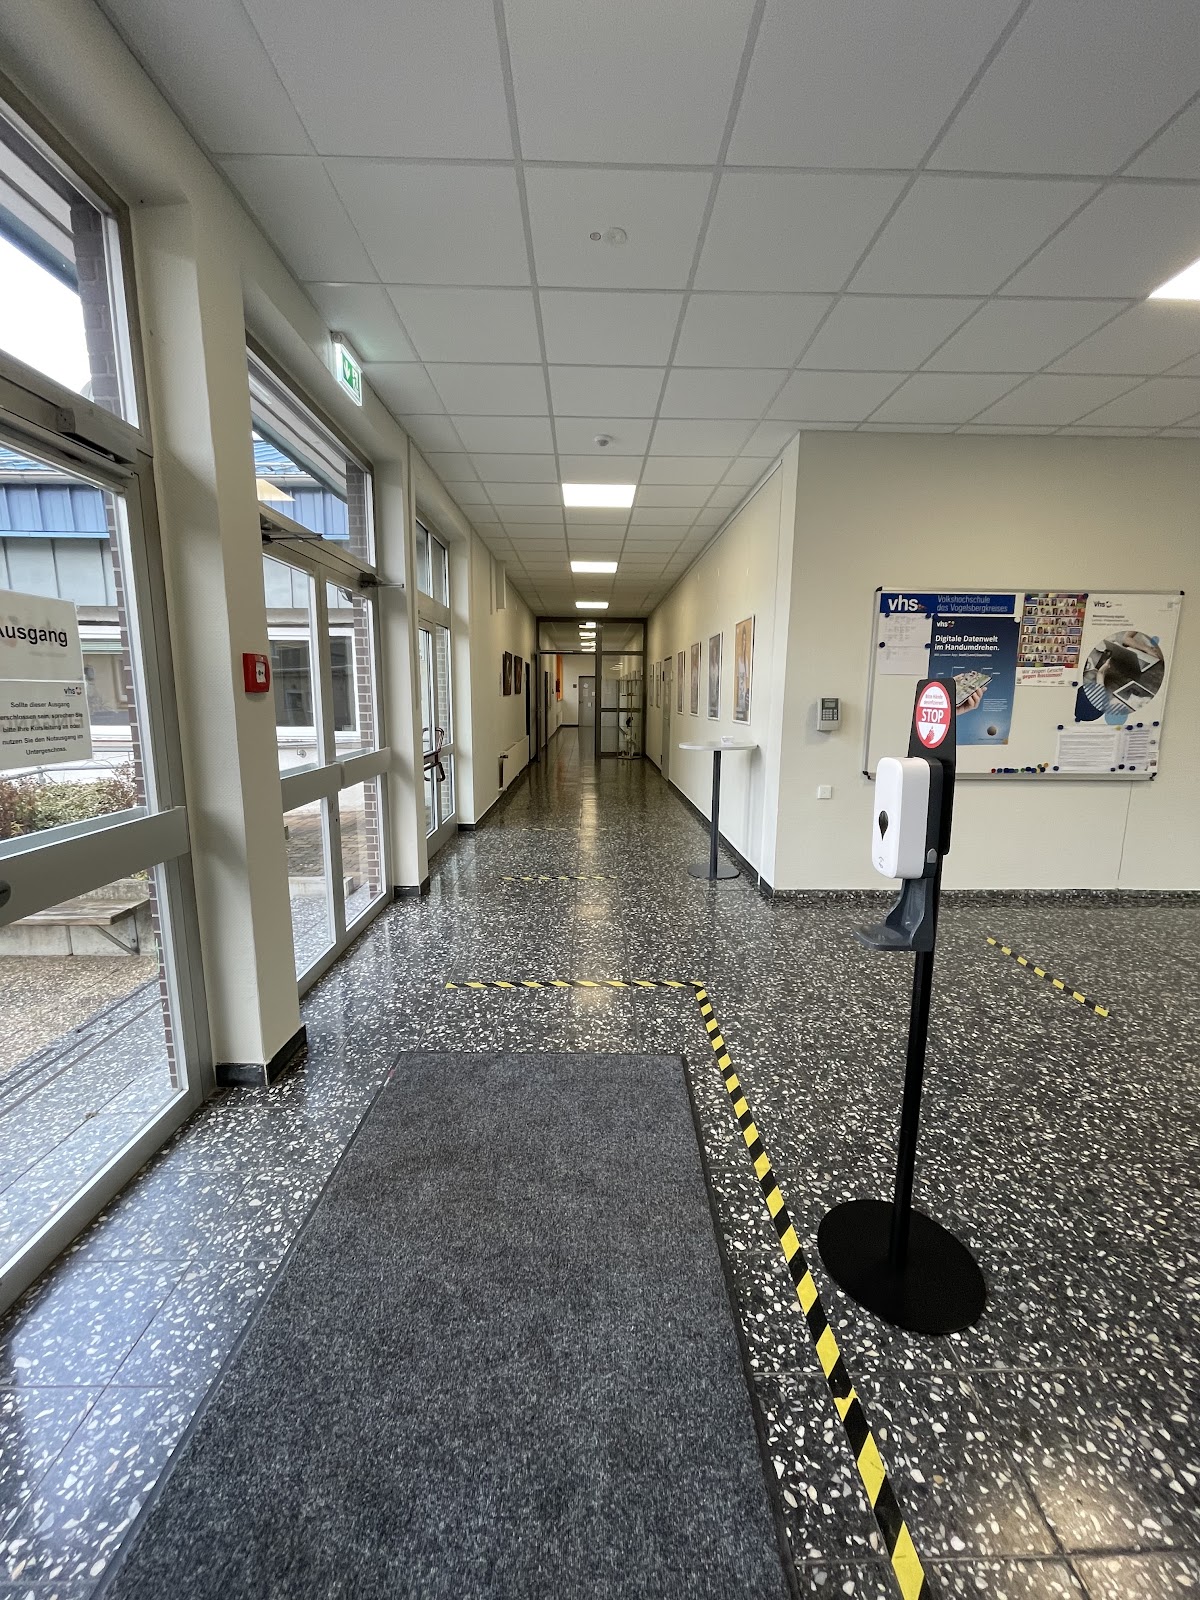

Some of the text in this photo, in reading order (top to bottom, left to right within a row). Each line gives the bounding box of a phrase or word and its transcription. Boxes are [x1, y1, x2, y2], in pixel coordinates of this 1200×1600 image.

[888, 595, 919, 611] vhs
[938, 595, 990, 604] Volkshochschule
[1093, 600, 1105, 608] vhs
[950, 604, 1008, 613] Vogelsbergkreises
[935, 635, 998, 643] Digitale Datenwelt
[64, 686, 76, 695] vhs
[921, 708, 944, 723] STOP
[26, 747, 67, 755] Untergeschoss.
